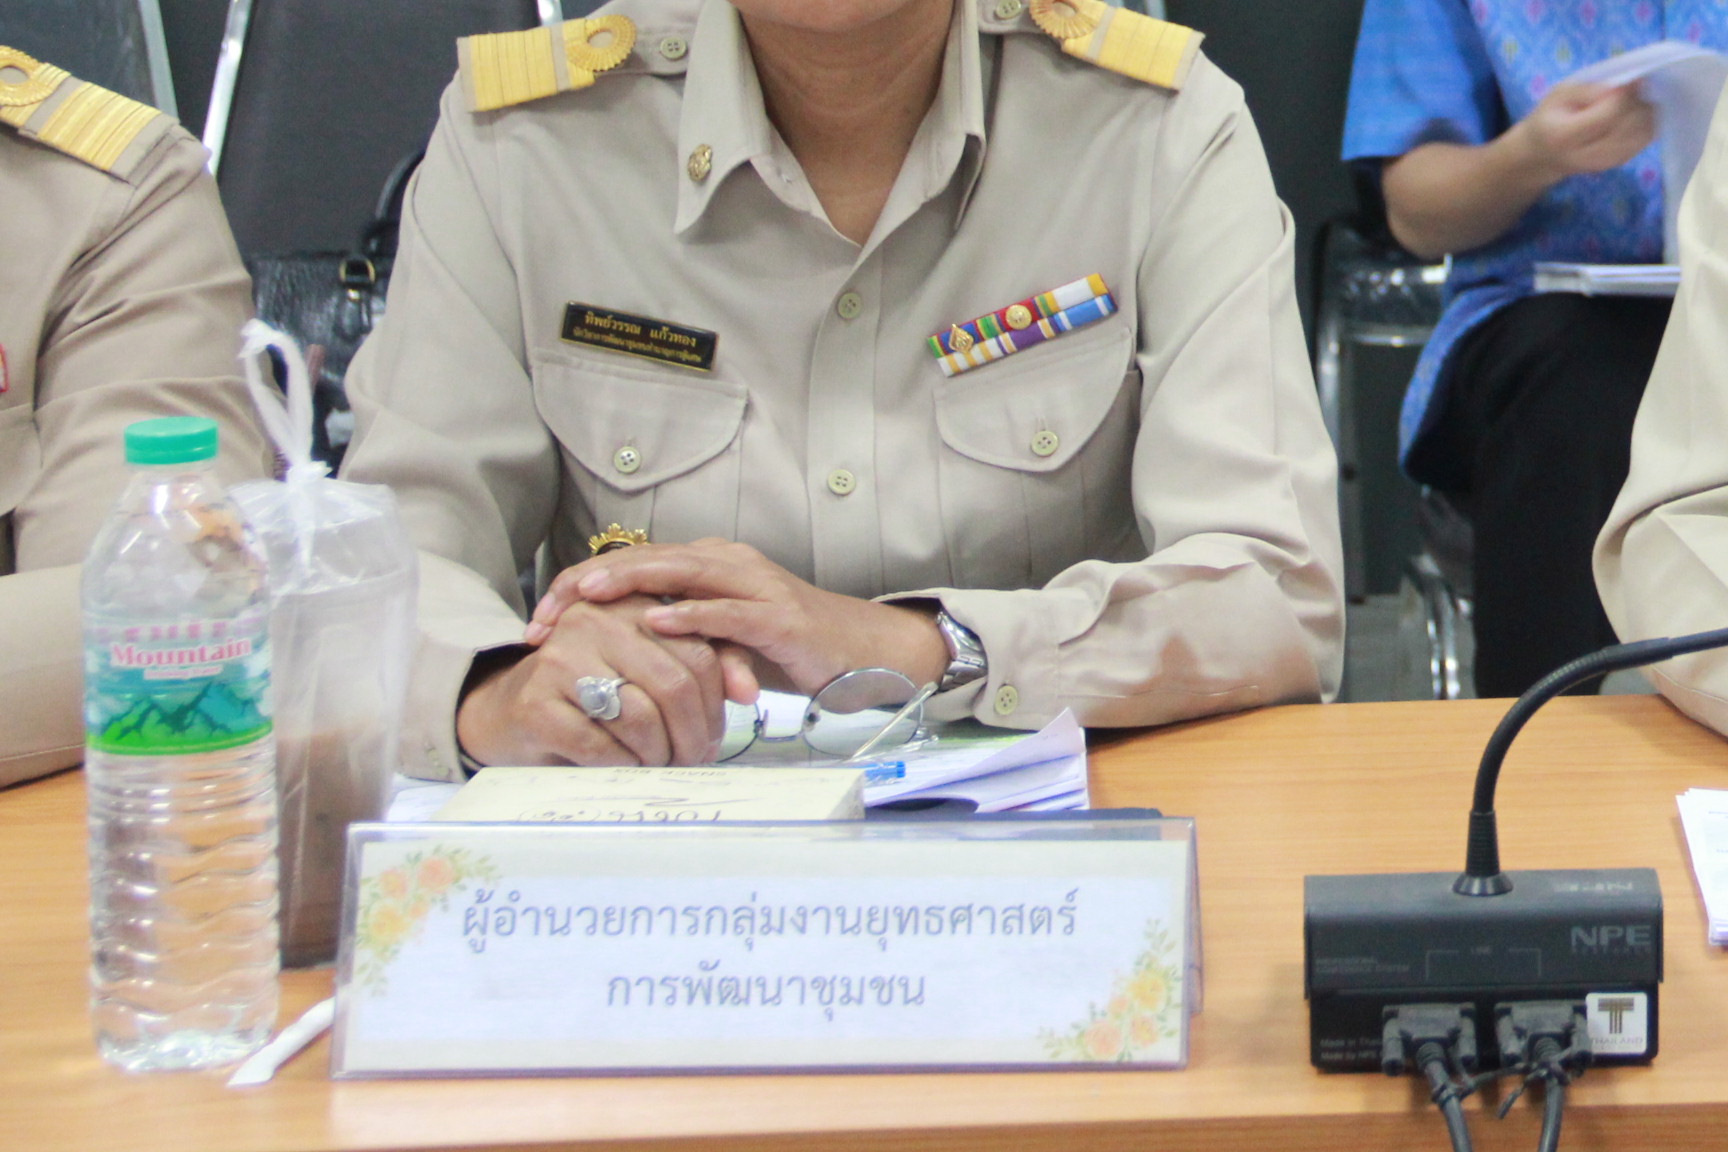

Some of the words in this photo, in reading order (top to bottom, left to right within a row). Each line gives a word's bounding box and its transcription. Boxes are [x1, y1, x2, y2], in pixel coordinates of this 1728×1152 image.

[111, 637, 251, 666] Mountain
[462, 888, 1079, 953] ผู้อำนวยการกลุ่มงานยุทธศาสตร์
[1571, 925, 1651, 947] NPE
[608, 959, 925, 1019] การพัฒนาชุมชน
